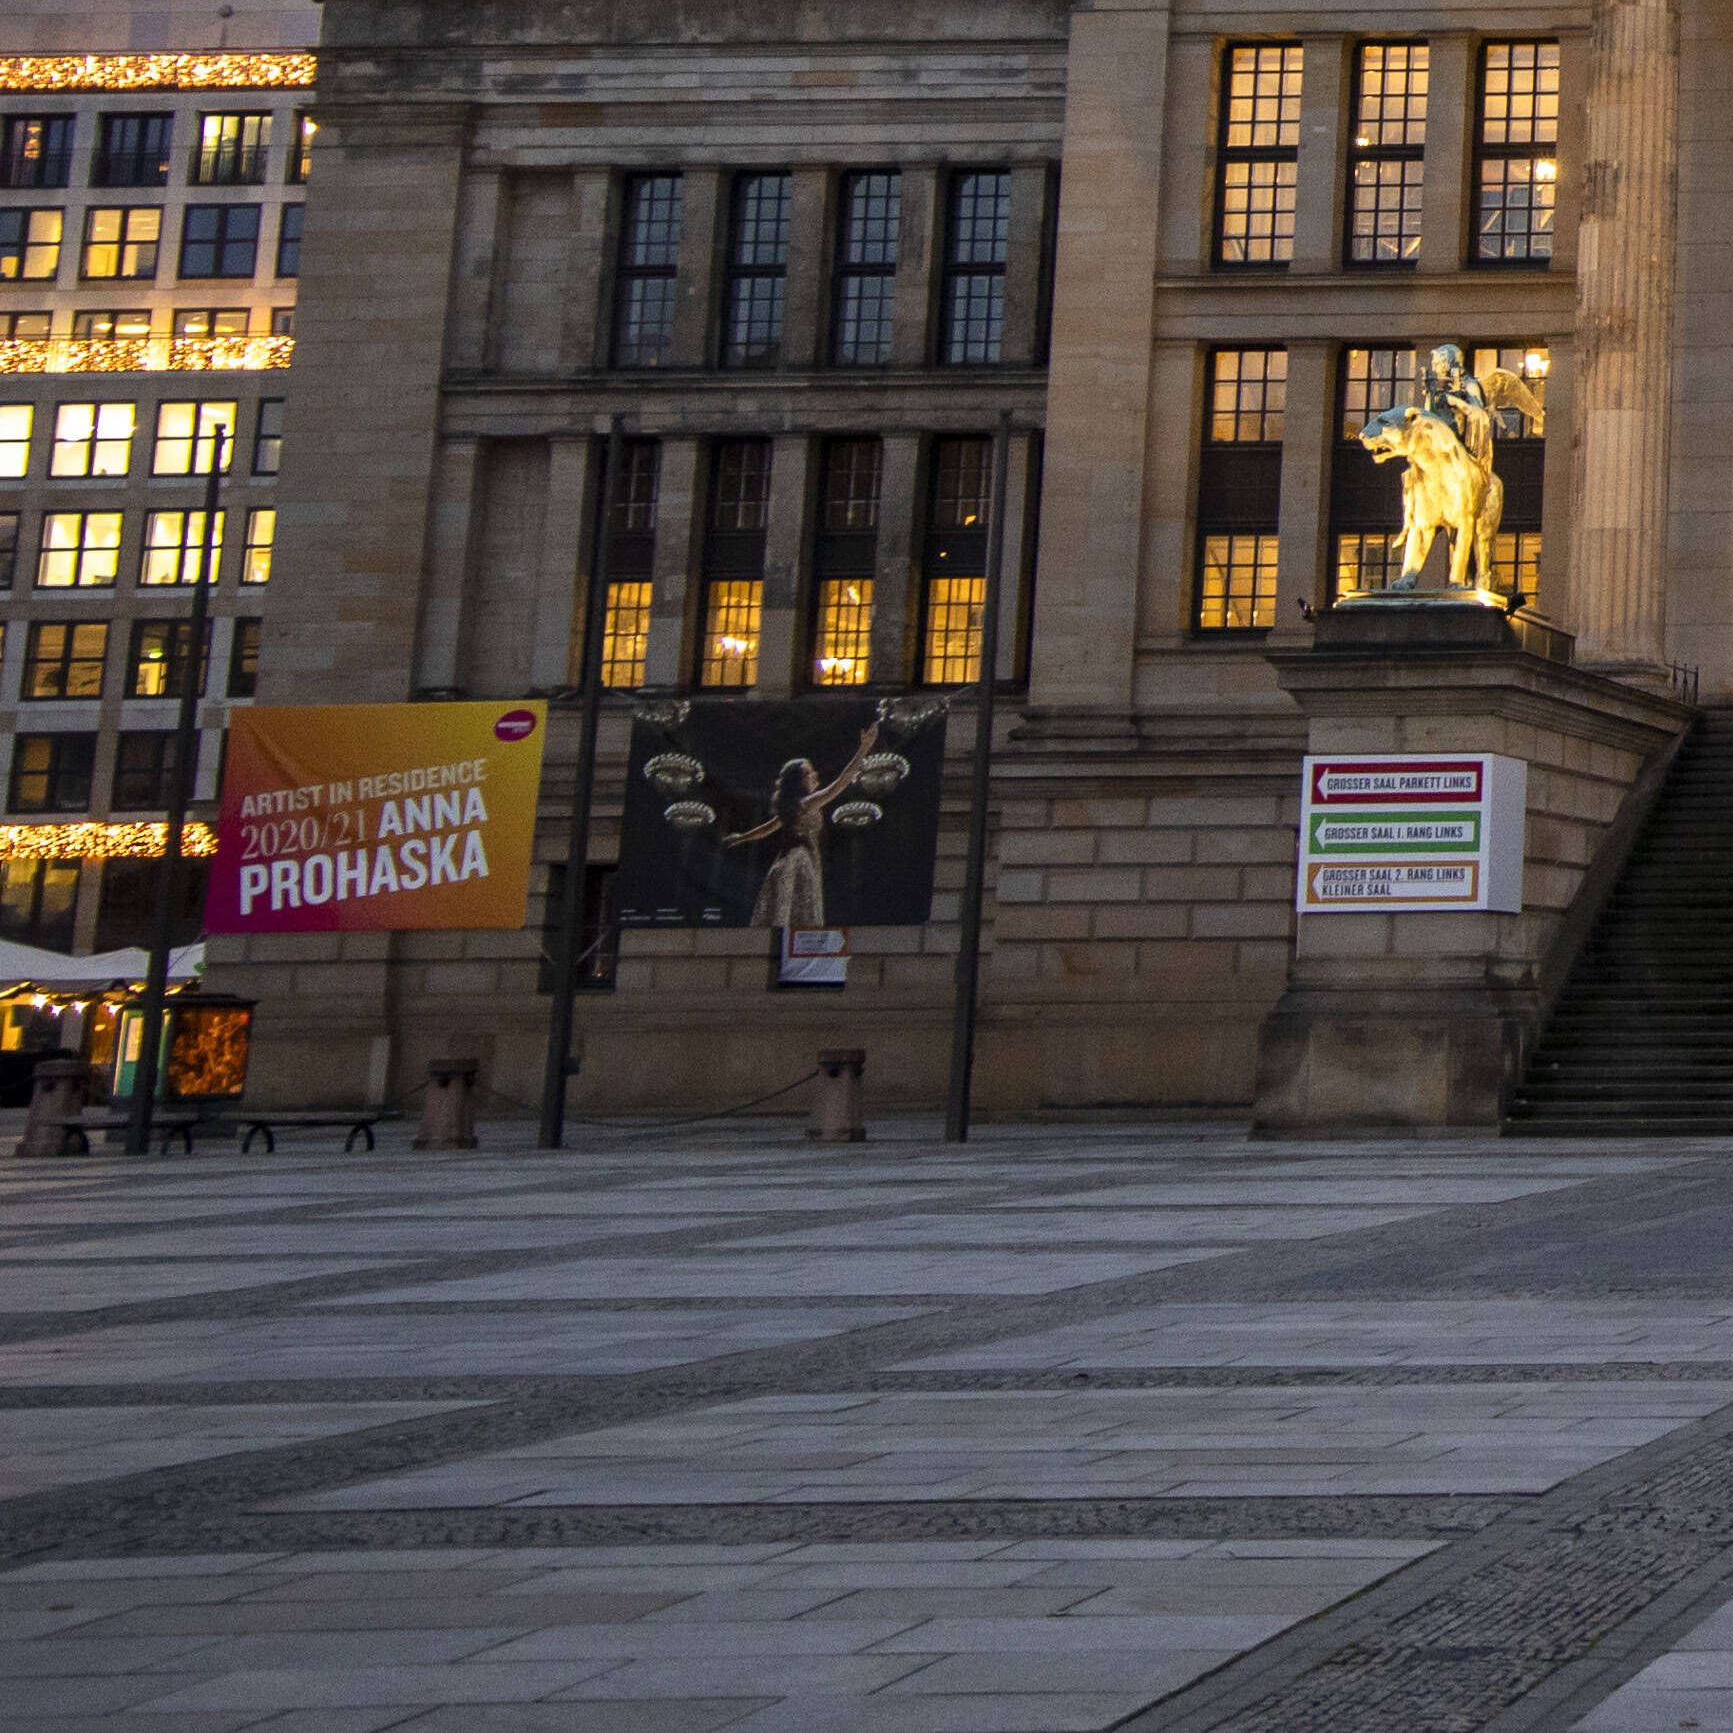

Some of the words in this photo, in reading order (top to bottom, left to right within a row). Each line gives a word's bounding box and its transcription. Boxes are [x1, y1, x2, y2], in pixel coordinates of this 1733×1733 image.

[240, 784, 324, 818] ARTIST
[329, 780, 353, 804] IN
[358, 758, 488, 800] RESIDENCE
[1327, 778, 1370, 790] GROSSER
[1374, 778, 1396, 789] SAAL
[1400, 777, 1441, 789] PARKETT
[1444, 776, 1471, 788] LINKS
[241, 809, 368, 860] 2020/21
[378, 787, 488, 838] ANNA
[1325, 827, 1368, 840] GROSSER
[1371, 827, 1394, 839] SAAL
[1407, 827, 1432, 838] RANG
[1435, 826, 1463, 838] LINKS
[240, 830, 489, 916] PROHASKA
[1323, 869, 1366, 881] GROSSER
[1369, 869, 1392, 880] SAAL
[1407, 868, 1433, 880] RANG
[1436, 868, 1465, 880] LINKS
[1322, 884, 1364, 896] KLEINER
[1367, 884, 1391, 895] SAAL
